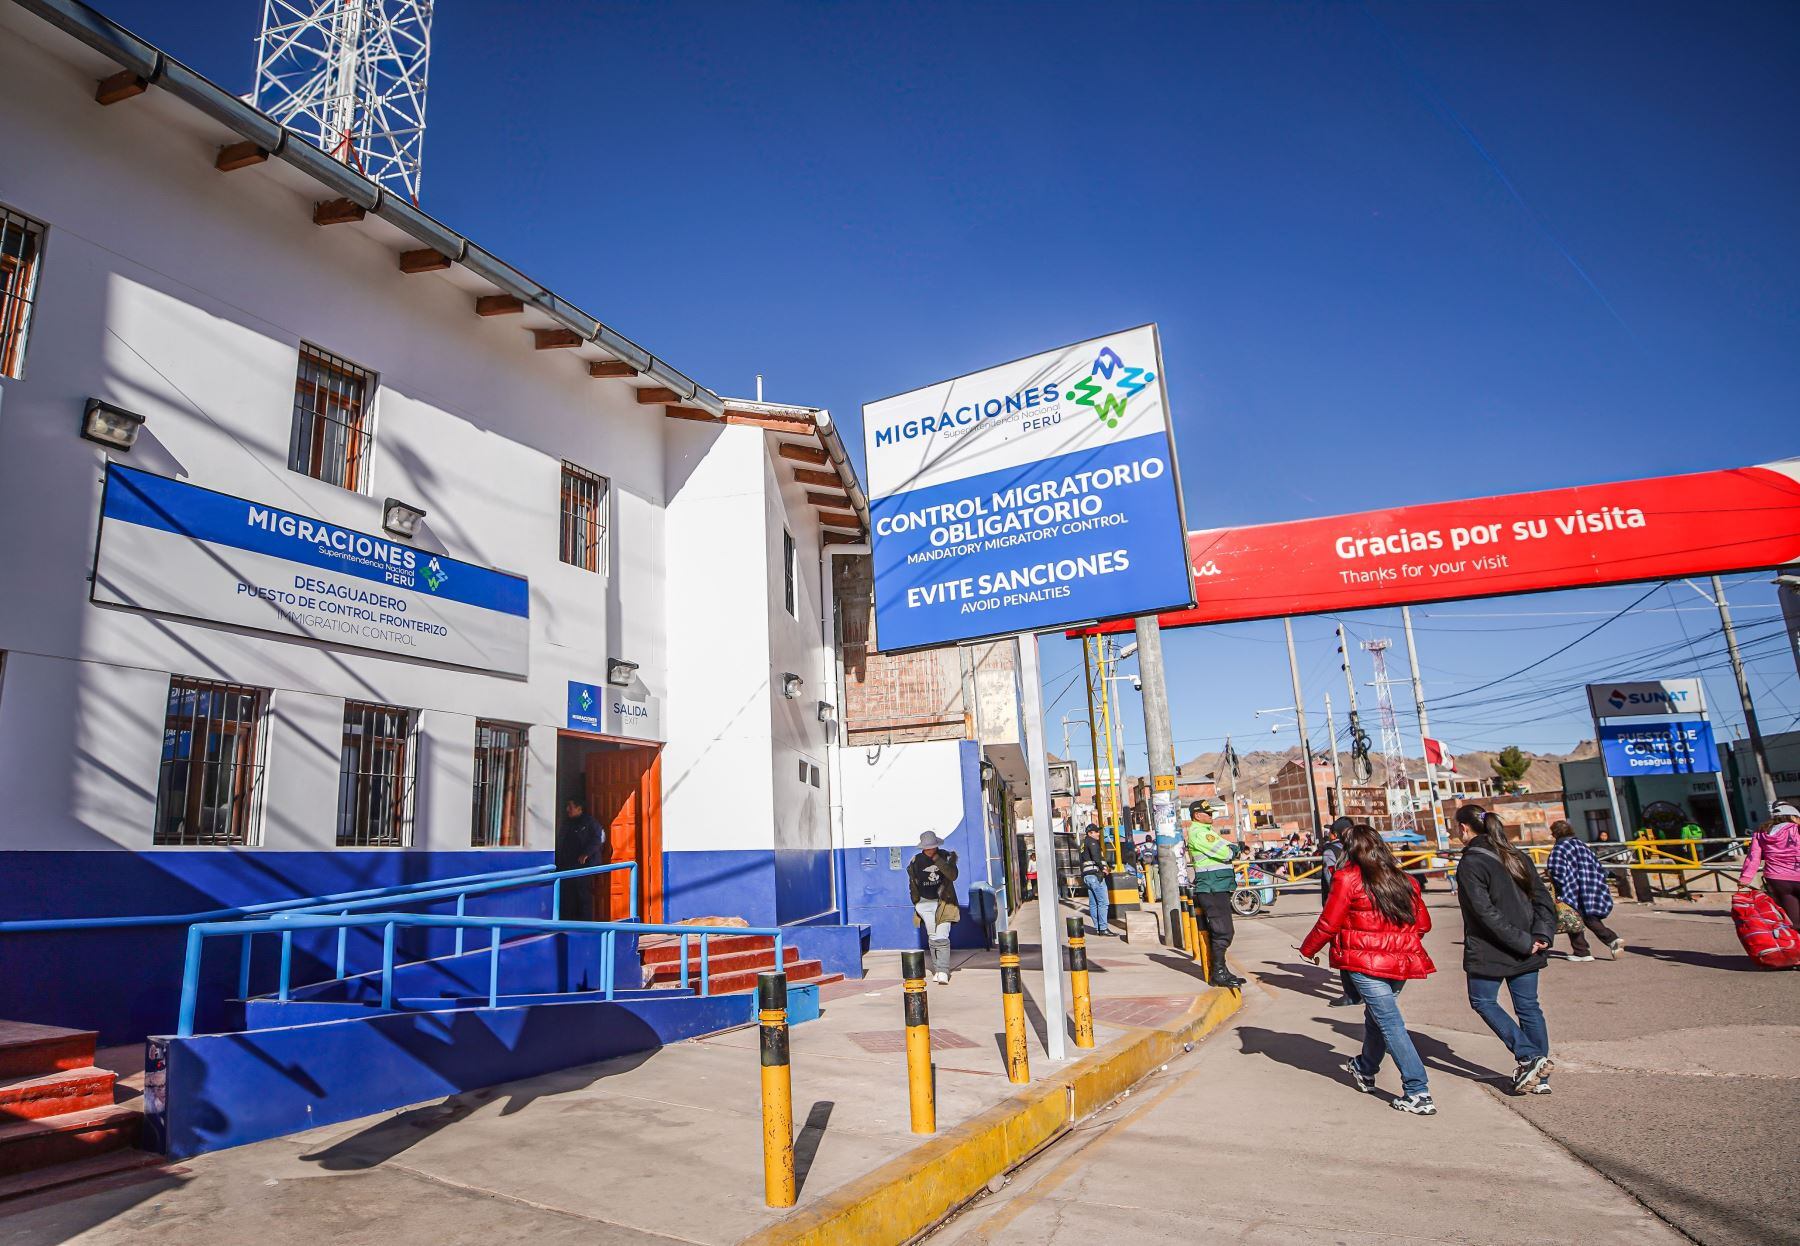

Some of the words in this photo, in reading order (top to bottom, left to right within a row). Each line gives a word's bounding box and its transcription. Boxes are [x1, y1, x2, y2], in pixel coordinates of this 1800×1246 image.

[875, 383, 1060, 448] MIGRACIONES
[943, 414, 1019, 439] Superintendencia
[1022, 402, 1061, 419] Nacional
[1023, 412, 1061, 431] PERÚ
[876, 497, 988, 537] CONTROL
[992, 457, 1164, 513] MIGRATORIO
[248, 506, 416, 569] MIGRACIONES
[907, 541, 983, 564] MANDATORY
[985, 526, 1060, 550] MIGRATORY
[1062, 513, 1129, 535] CONTROL
[930, 495, 1103, 547] OBLIGATORIO
[1335, 528, 1444, 559] Gracias
[1450, 520, 1502, 550] por
[1512, 519, 1548, 541] su
[1555, 505, 1646, 536] visita
[318, 546, 385, 569] Superintendencia
[385, 564, 415, 577] Nacional
[907, 578, 974, 608] EVITE
[978, 550, 1130, 595] SANCIONES
[1340, 567, 1397, 584] Thanks
[1401, 564, 1423, 579] for
[1429, 561, 1466, 577] your
[1472, 554, 1509, 569] visit
[237, 583, 296, 605] PUESTO
[298, 595, 316, 609] DE
[318, 600, 377, 622] CONTROL
[379, 613, 448, 637] FRONTERIZO
[295, 575, 407, 612] DESAGUADERO
[961, 597, 1001, 614] AVOID
[1003, 586, 1071, 607] PENALTIES
[277, 609, 360, 635] IMMIGRATION
[362, 626, 417, 646] CONTROL
[613, 702, 648, 717] SALIDA
[1628, 690, 1688, 704] SUNAT
[625, 716, 639, 726] EXIT
[1617, 731, 1673, 743] PUESTO
[1676, 729, 1698, 741] DE
[1624, 741, 1695, 755] CONTROL
